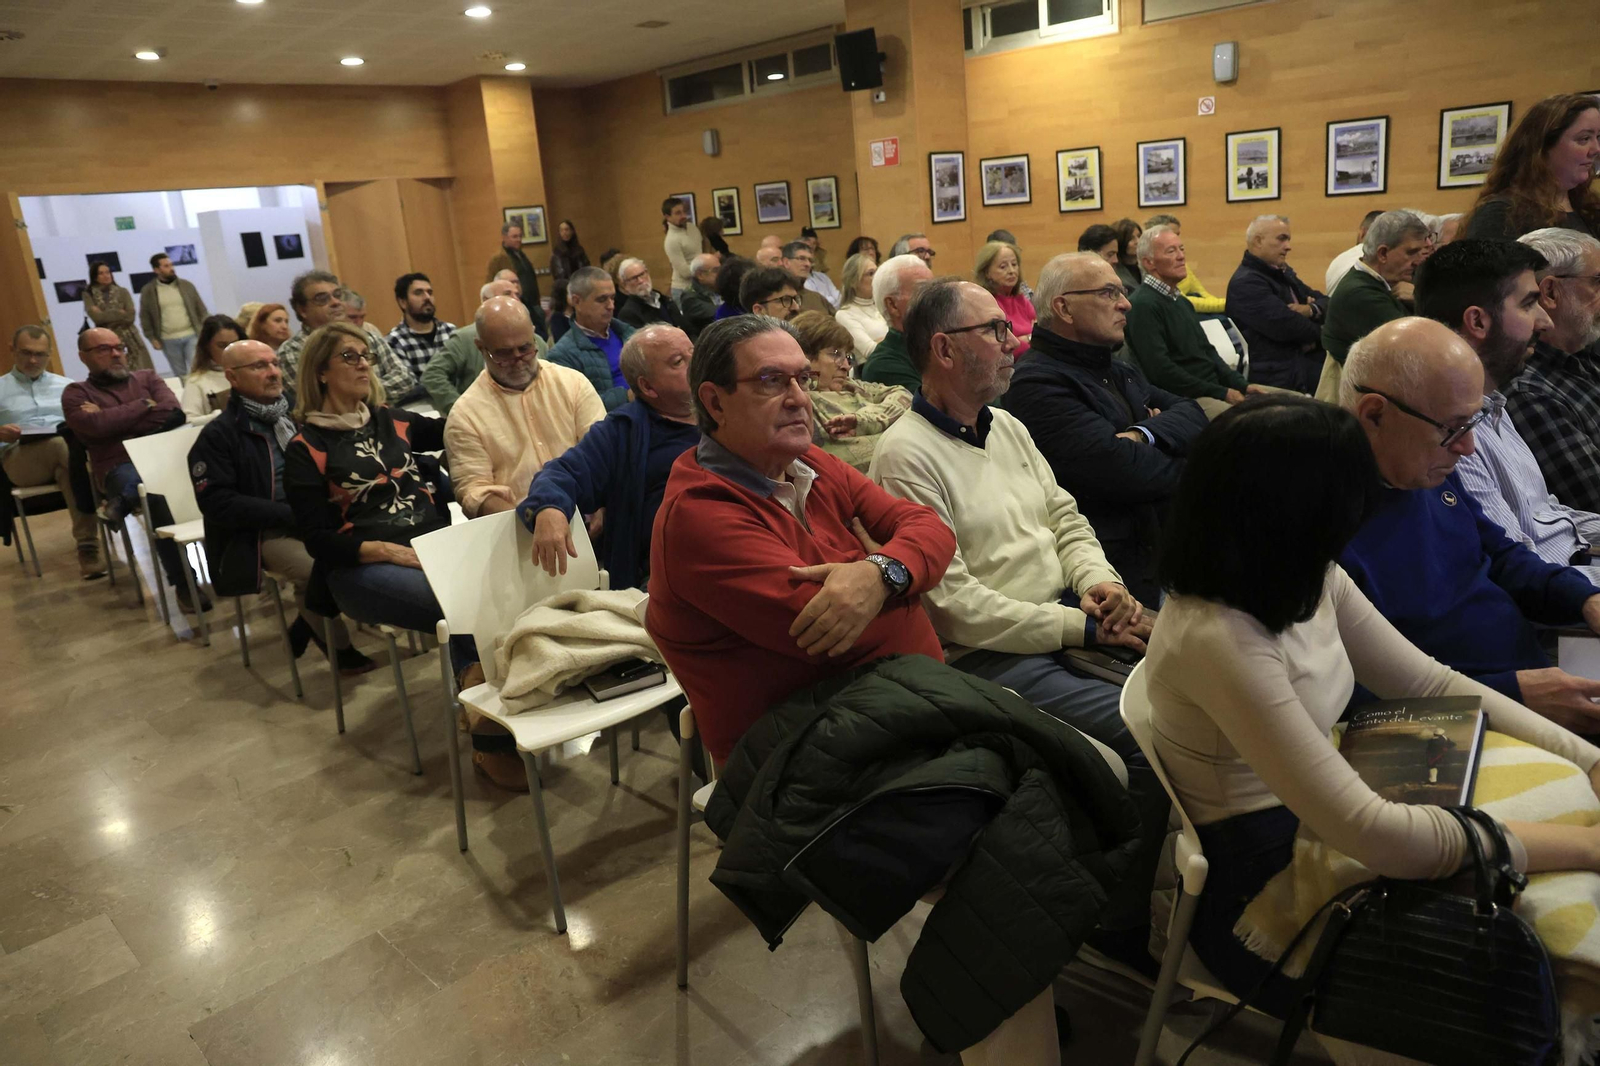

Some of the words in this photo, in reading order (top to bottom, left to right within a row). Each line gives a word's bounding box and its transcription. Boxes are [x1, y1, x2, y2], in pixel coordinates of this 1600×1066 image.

[1354, 711, 1391, 720] Como
[1394, 707, 1406, 715] el
[1351, 718, 1386, 728] viento
[1389, 715, 1405, 723] de
[1409, 714, 1463, 723] Levante
